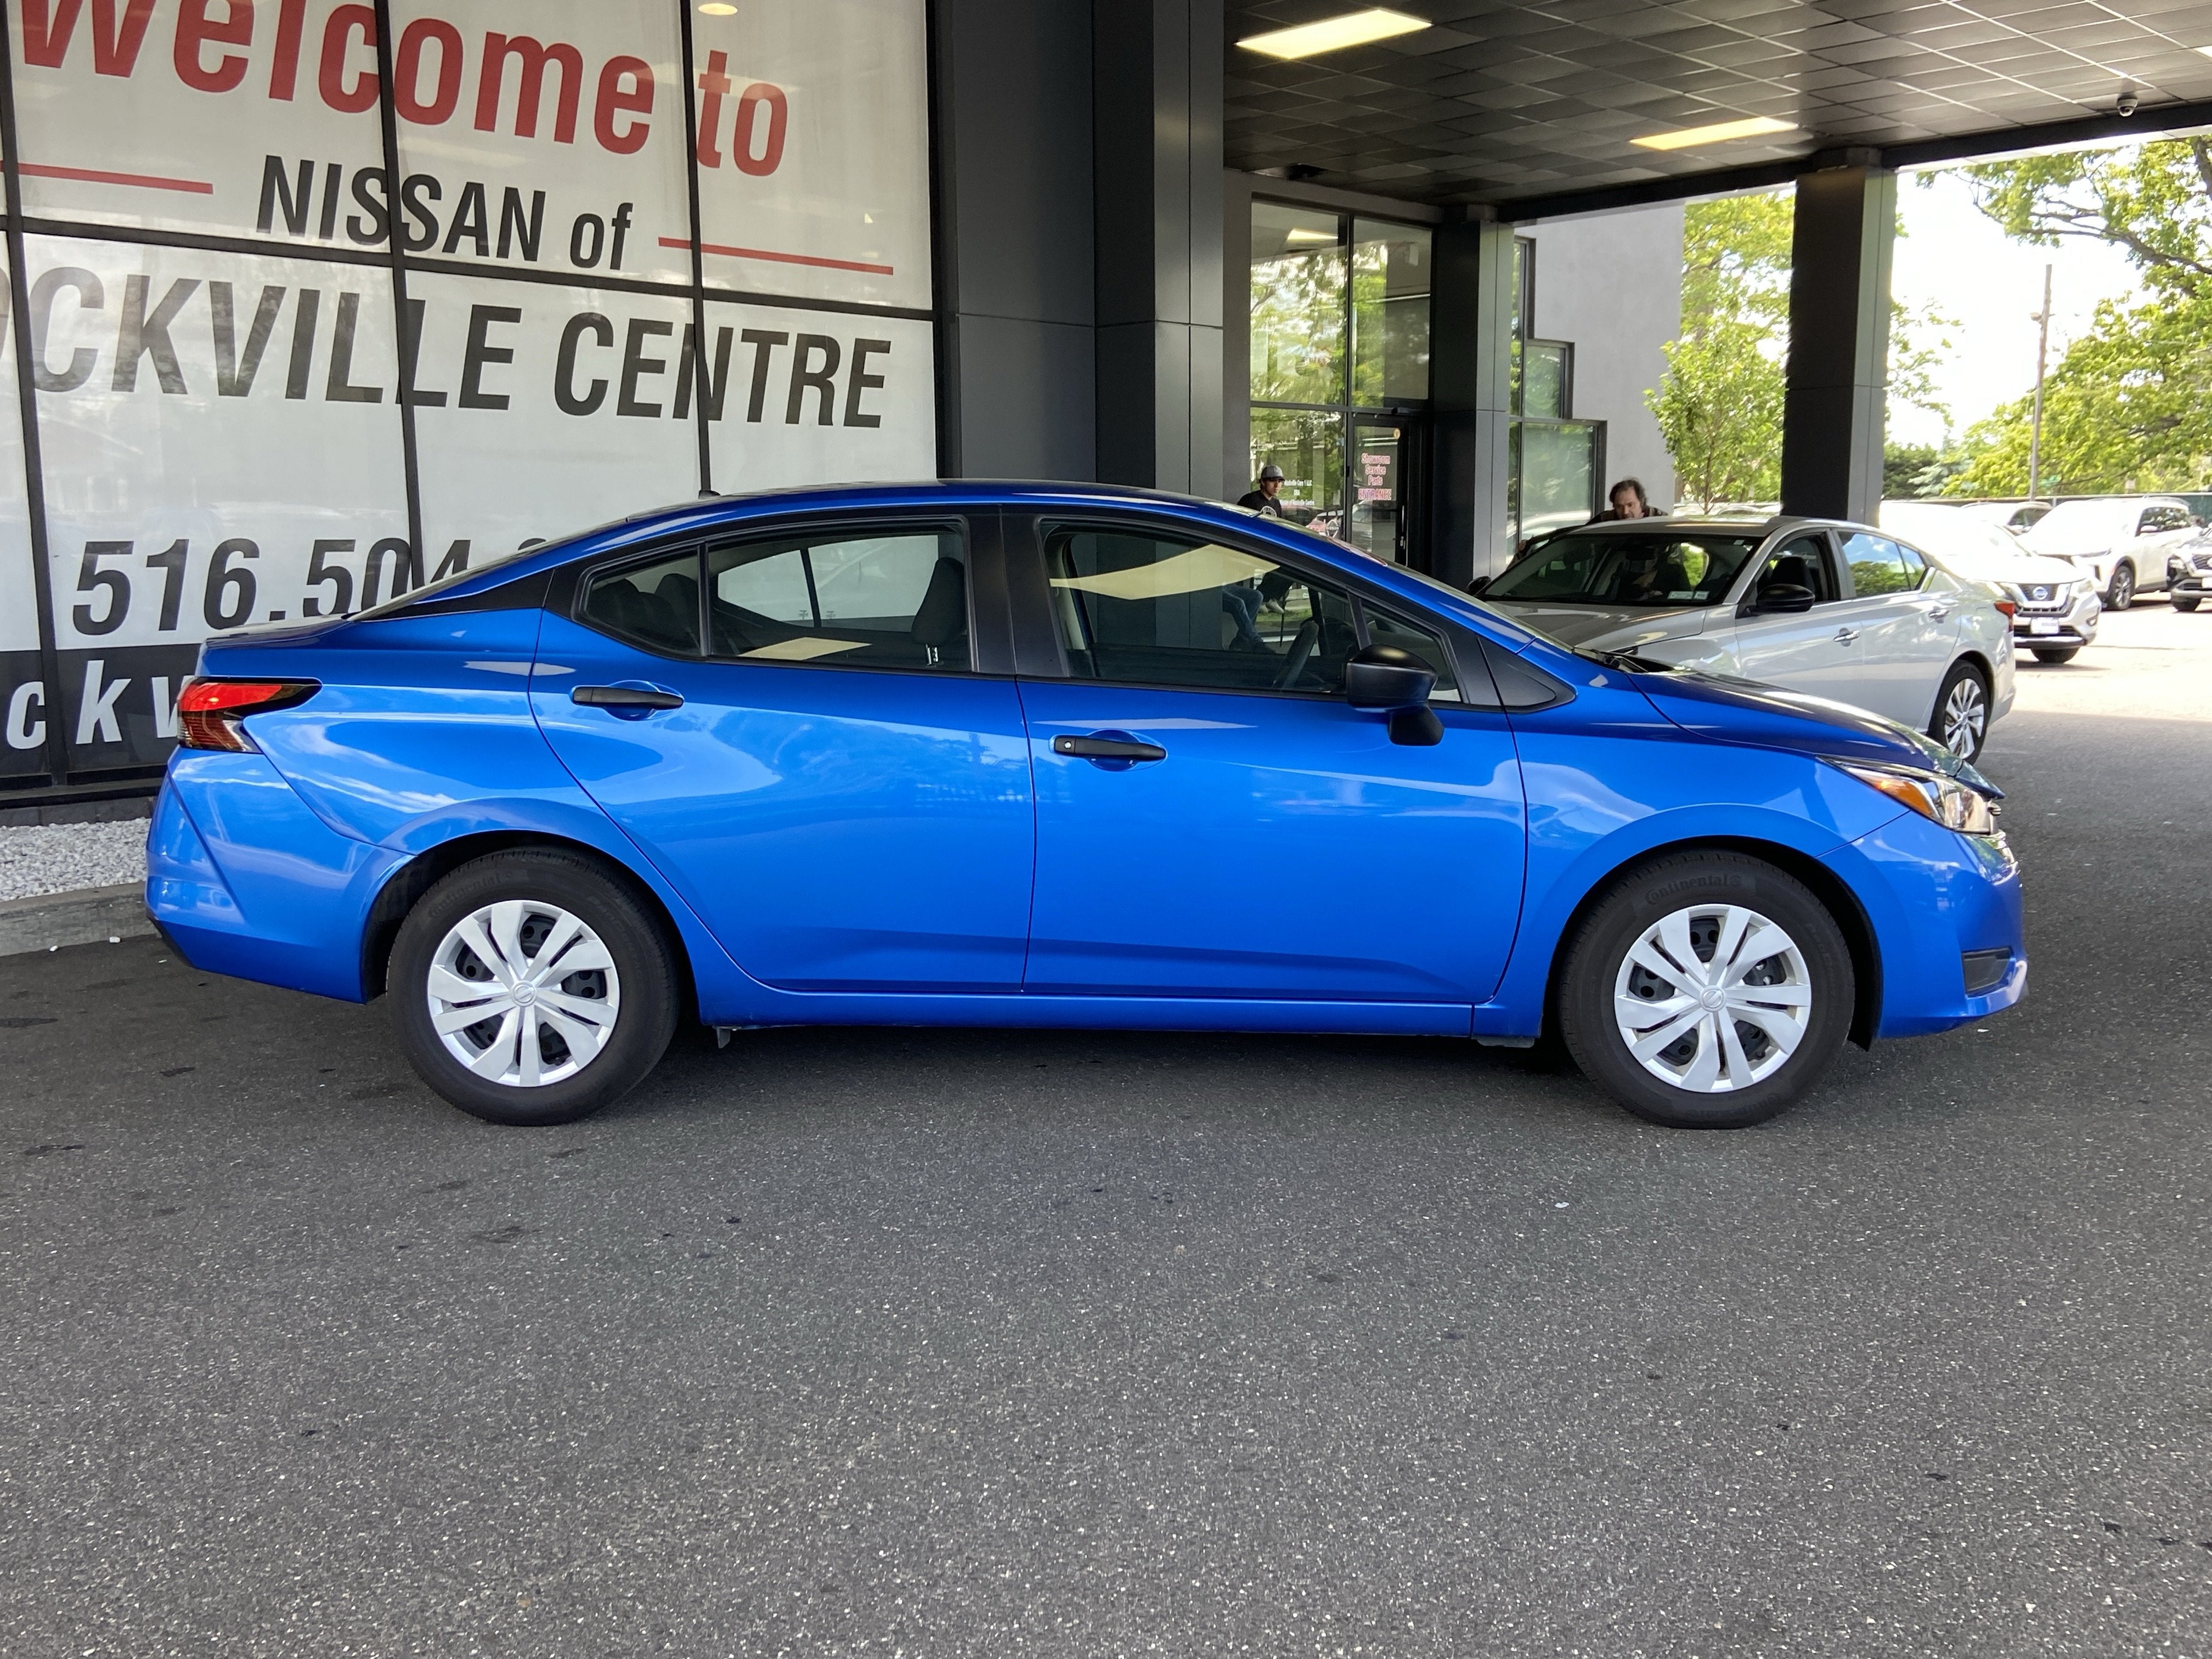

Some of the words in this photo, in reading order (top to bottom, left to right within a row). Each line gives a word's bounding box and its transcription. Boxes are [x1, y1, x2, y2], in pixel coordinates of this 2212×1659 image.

[19, 0, 654, 155] Welcome
[697, 50, 788, 177] to
[256, 155, 546, 262] NISSAN
[569, 202, 634, 270] of
[0, 267, 522, 410] CKVILLE
[554, 312, 891, 428] CENTRE
[1361, 453, 1391, 465] Showroom
[1365, 464, 1386, 475] Service
[1368, 475, 1383, 486] Parts
[1358, 488, 1392, 500] ENTRANCE
[1645, 874, 1729, 905] Continental
